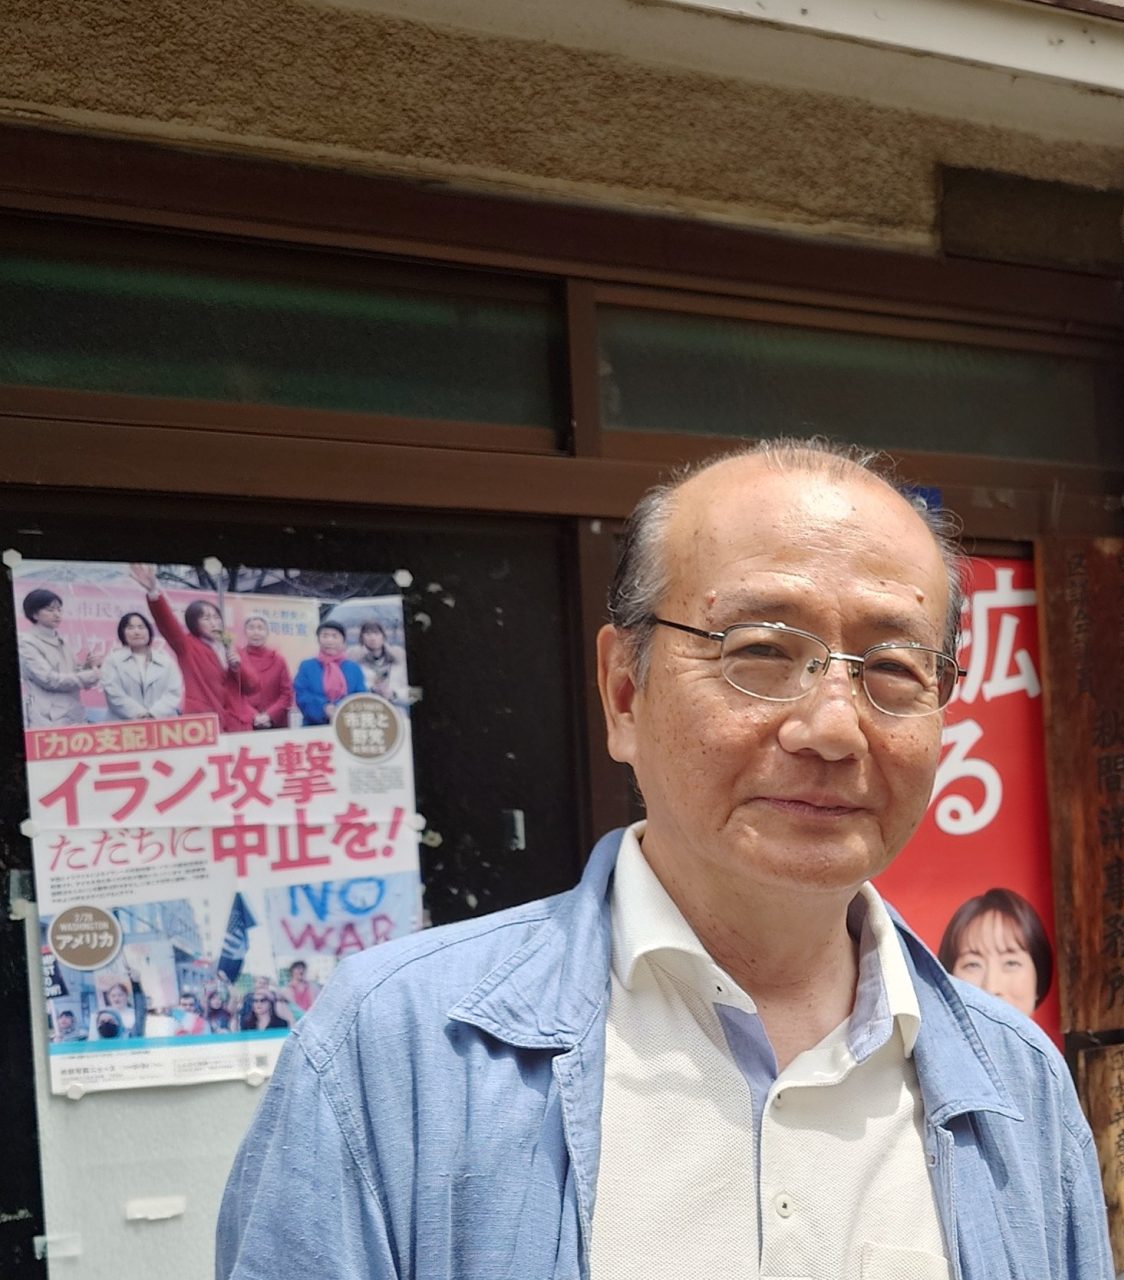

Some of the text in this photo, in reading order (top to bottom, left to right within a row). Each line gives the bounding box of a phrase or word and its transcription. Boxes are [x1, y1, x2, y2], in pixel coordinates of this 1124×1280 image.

[33, 721, 214, 757] 「力の支配」NO!
[39, 741, 337, 827] イラン攻撃
[289, 876, 386, 921] NO
[55, 931, 114, 950] アメリカ
[59, 921, 110, 932] WASHINGTON
[281, 914, 396, 956] WAR
